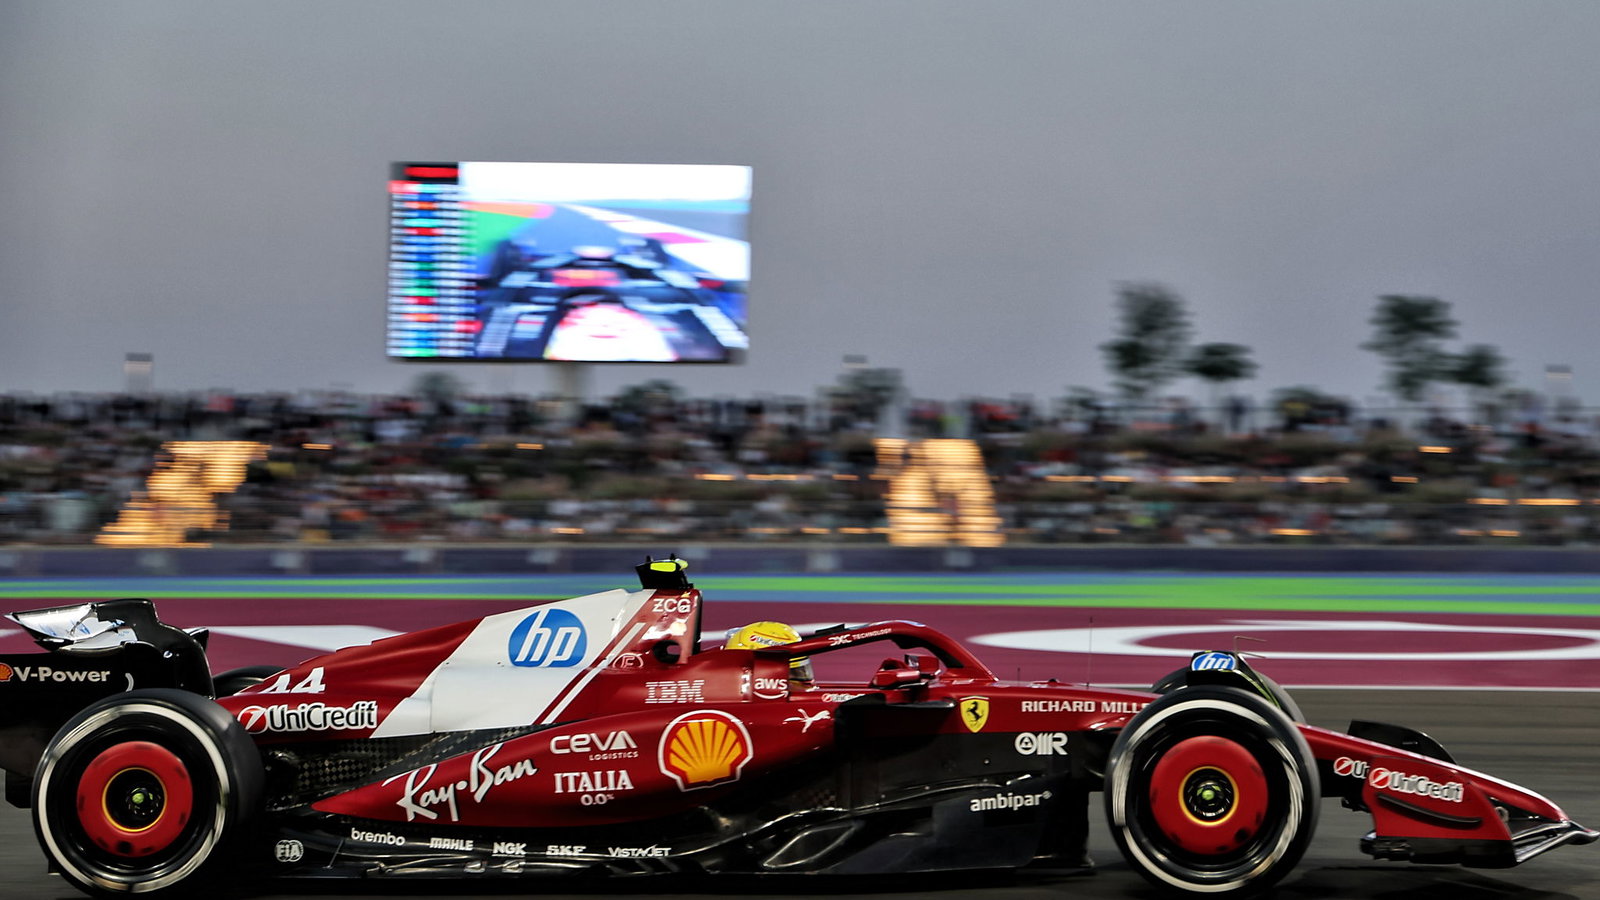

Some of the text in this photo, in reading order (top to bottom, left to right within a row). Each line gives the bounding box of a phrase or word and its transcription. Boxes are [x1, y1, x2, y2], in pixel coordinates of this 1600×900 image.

[514, 608, 582, 668] hp
[13, 666, 111, 682] V-Power
[257, 666, 326, 694] 44
[644, 679, 705, 704] IBM
[754, 677, 788, 690] aws
[1021, 700, 1096, 712] RICHARD
[268, 701, 377, 731] UniCredit
[589, 751, 639, 761] LOGISTICS
[553, 769, 635, 794] ITALIA
[1388, 771, 1464, 802] UniCredit
[351, 827, 406, 846] brembo
[429, 837, 474, 851] MAHLE
[492, 842, 528, 855] NGK
[546, 845, 587, 856] SKF
